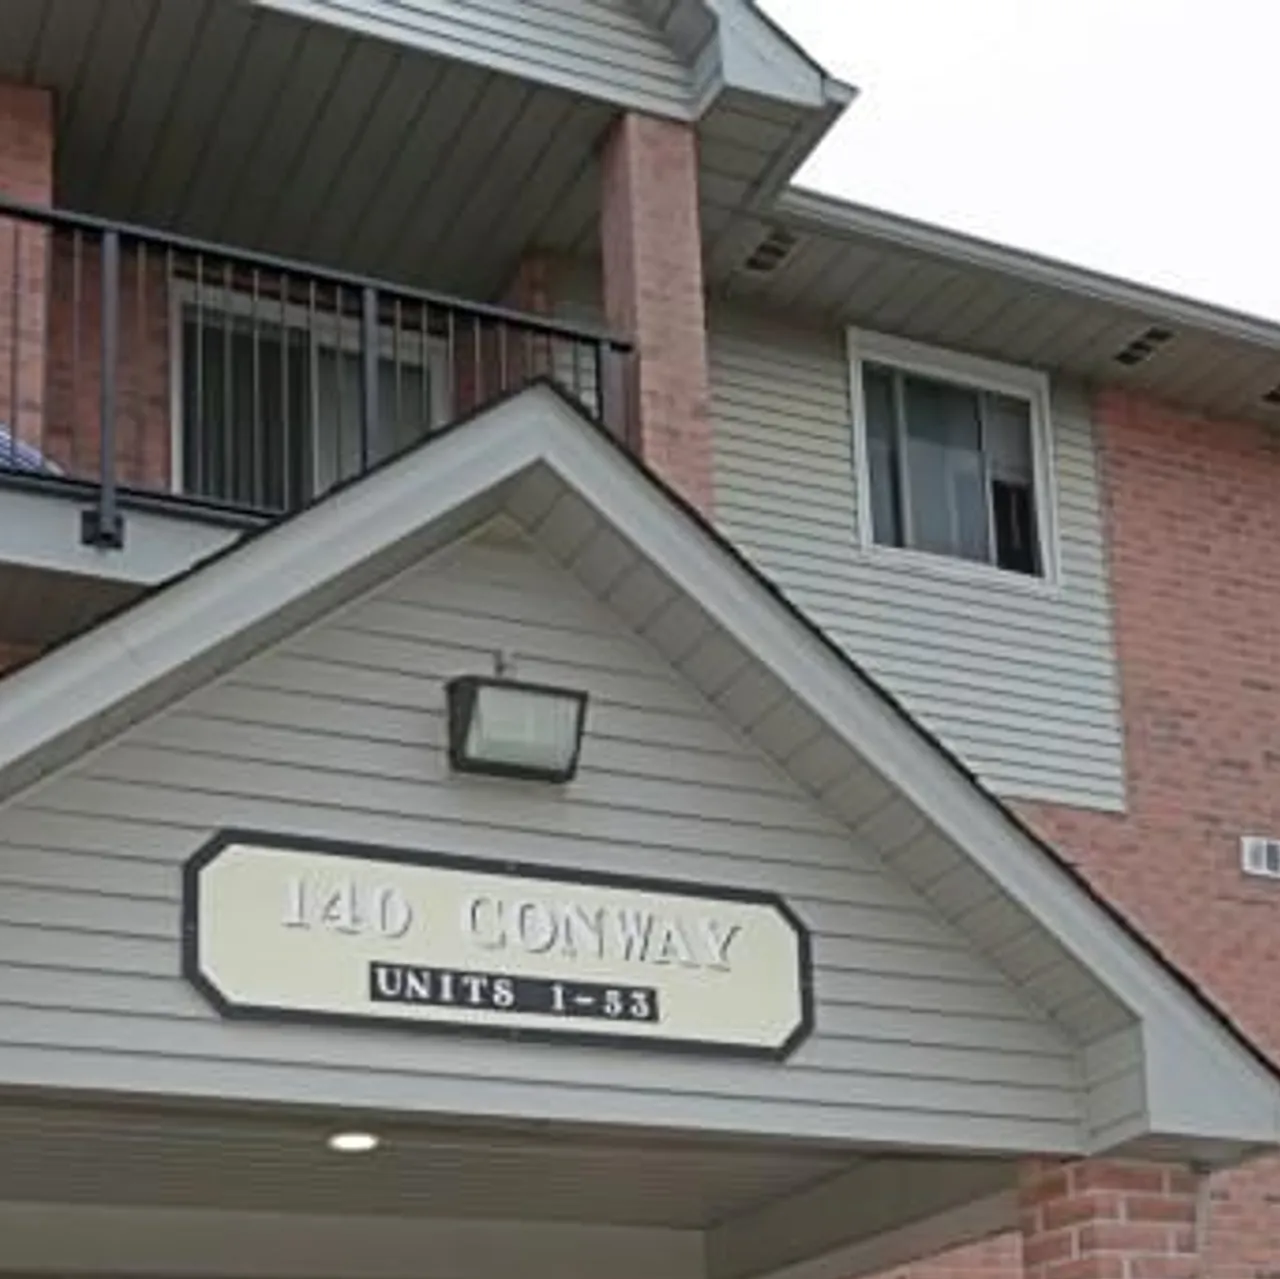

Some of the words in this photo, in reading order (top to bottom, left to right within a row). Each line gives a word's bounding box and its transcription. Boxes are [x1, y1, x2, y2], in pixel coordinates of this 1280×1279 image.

[281, 874, 414, 940] 140
[464, 896, 742, 973] CONWAY
[375, 966, 515, 1007] UNITS
[549, 983, 651, 1018] 1-53
